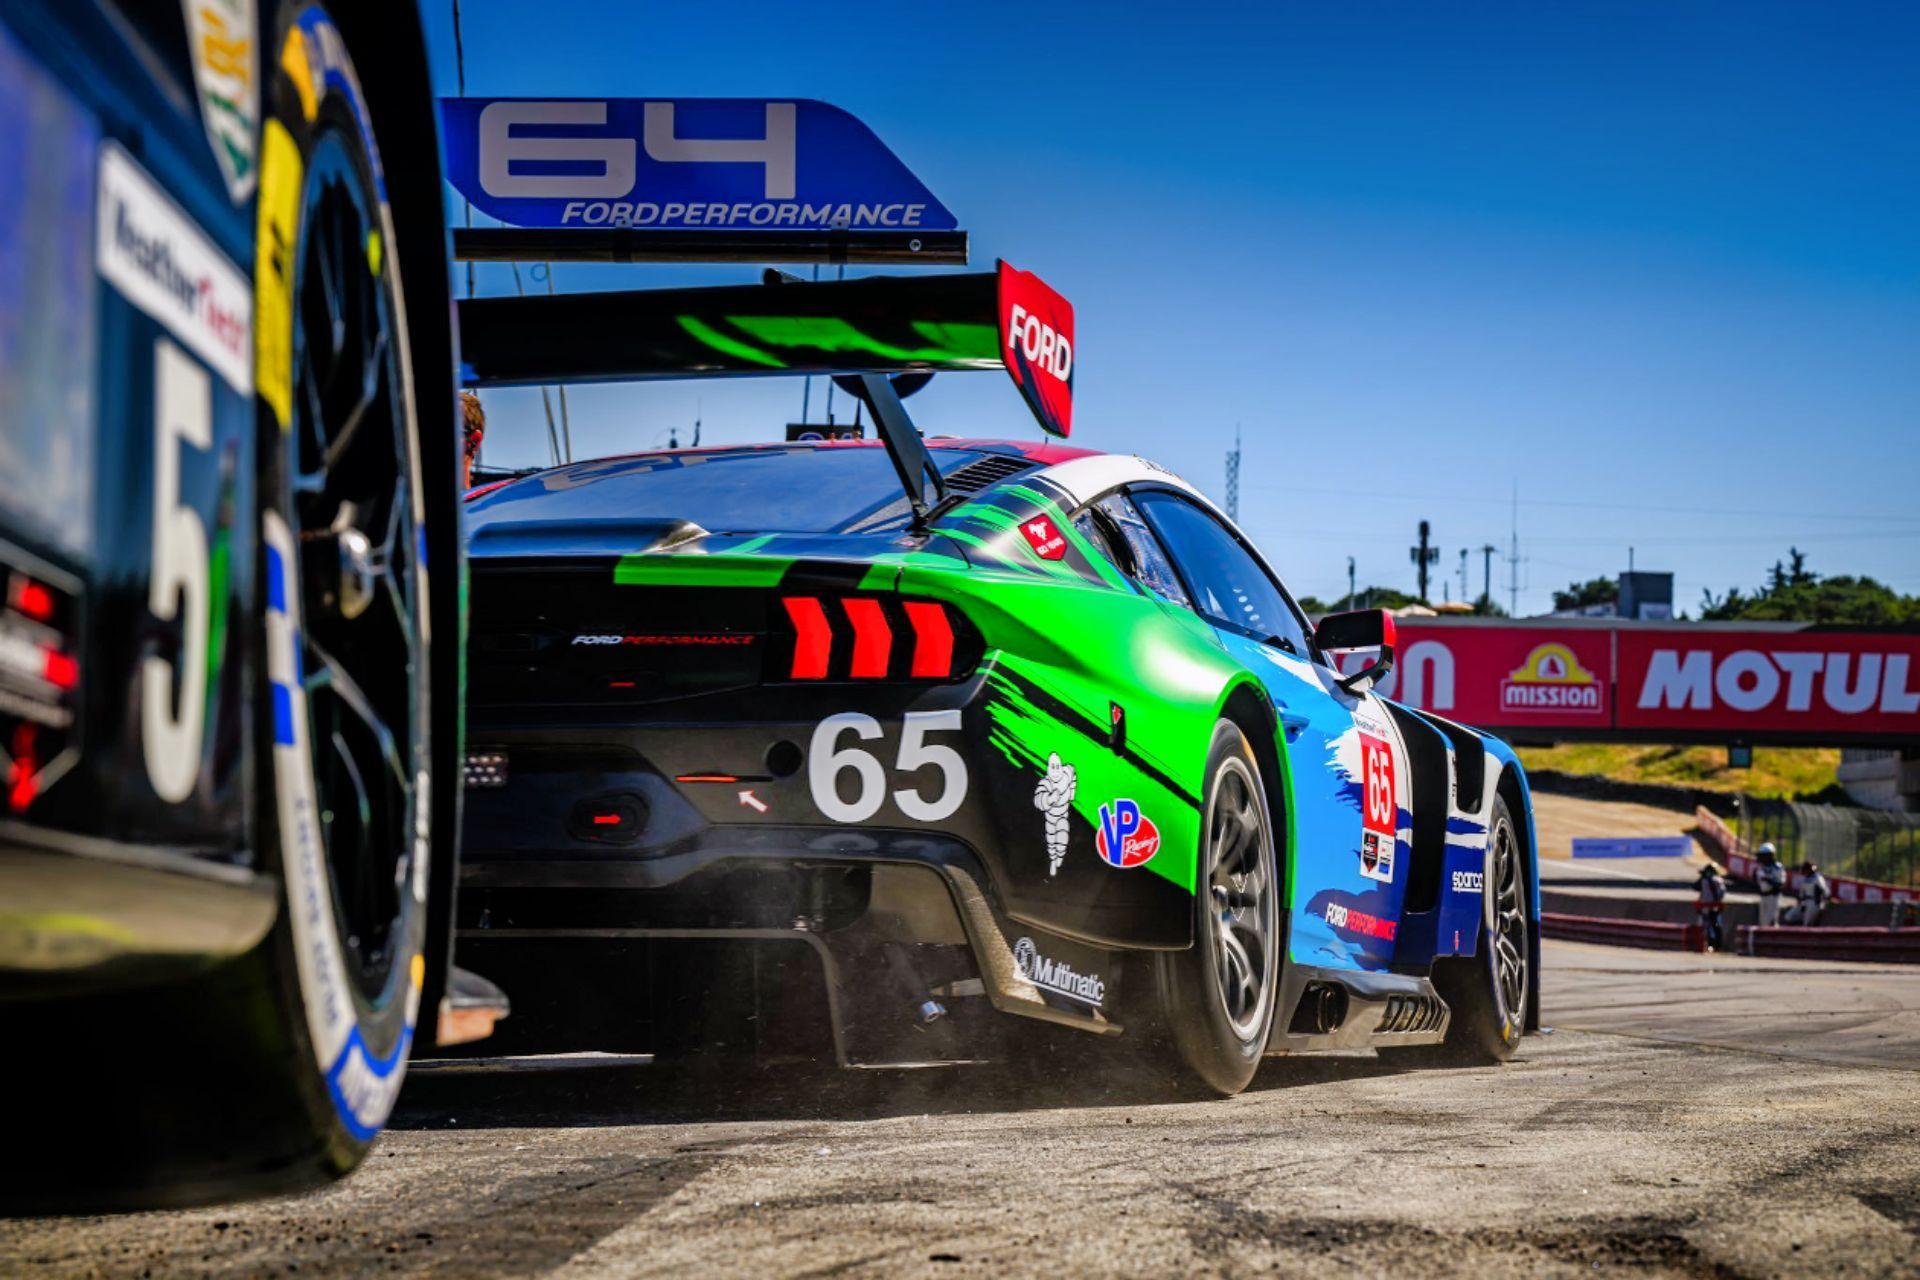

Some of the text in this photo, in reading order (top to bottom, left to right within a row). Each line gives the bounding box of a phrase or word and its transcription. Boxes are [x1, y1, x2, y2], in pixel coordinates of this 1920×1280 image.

[479, 101, 796, 200] 64
[1008, 303, 1071, 382] FORD
[1637, 650, 1920, 713] MOTUL
[808, 710, 968, 823] 65
[1368, 745, 1391, 825] 65
[1098, 798, 1140, 866] VP
[1034, 954, 1105, 1001] Multimatic
